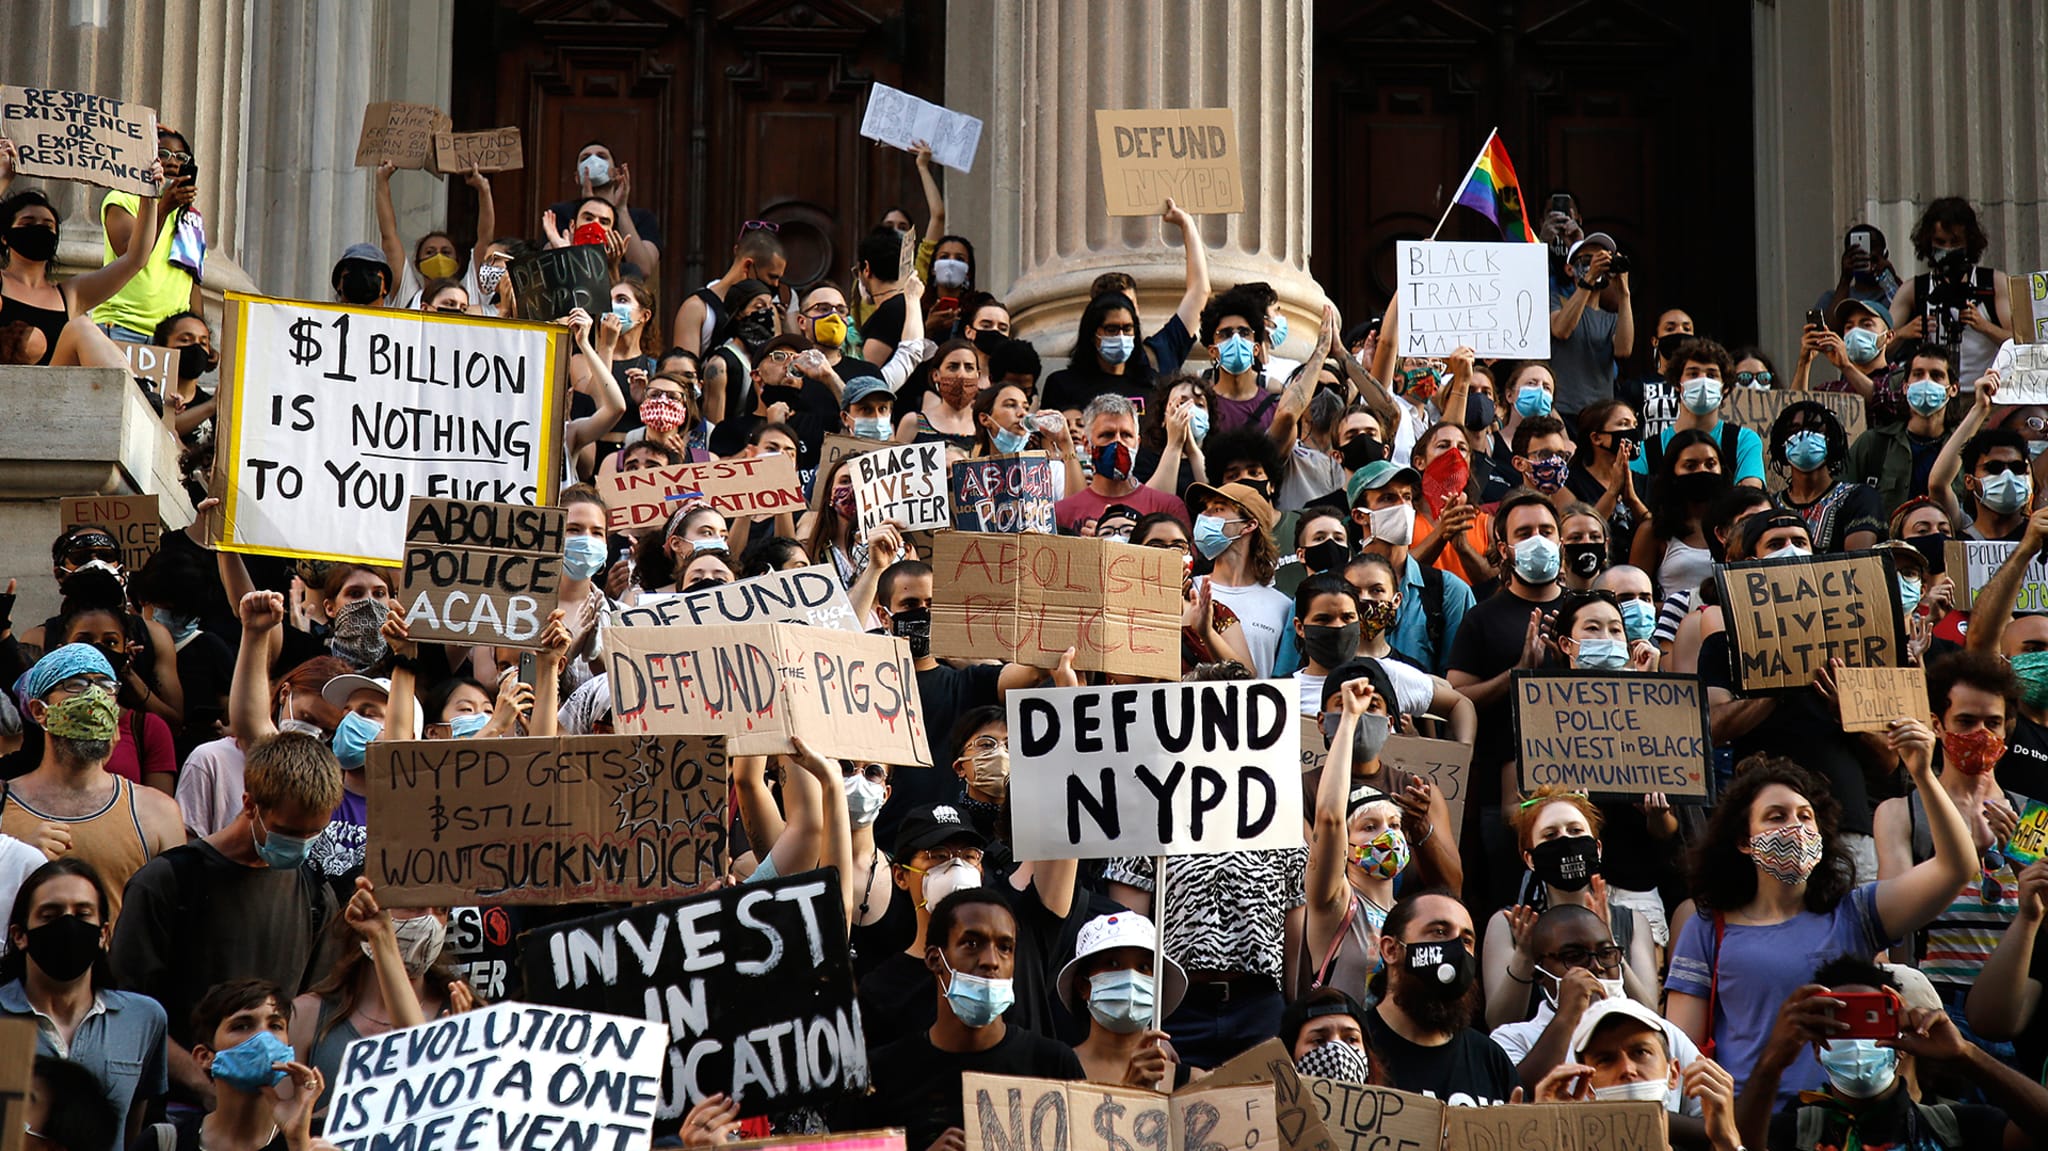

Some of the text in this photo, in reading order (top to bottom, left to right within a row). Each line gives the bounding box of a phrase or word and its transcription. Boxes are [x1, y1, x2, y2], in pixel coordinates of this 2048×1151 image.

[5, 104, 143, 139] EXISTENCE
[24, 89, 124, 117] RESPECT
[38, 134, 123, 160] EXPECT
[66, 123, 96, 141] OR
[440, 135, 517, 151] DEFUND
[1114, 126, 1226, 159] DEFUND
[18, 145, 155, 185] RESISTANCE
[458, 150, 510, 168] NYPD
[1123, 167, 1232, 207] NYPD
[513, 248, 605, 291] DEFUND
[1410, 247, 1501, 276] BLACK
[1408, 279, 1500, 306] TRANS
[1410, 308, 1498, 332] LIVES
[288, 314, 525, 393] $1 BILLION
[271, 395, 530, 471] IS NOTHING
[247, 459, 303, 500] TO
[324, 460, 404, 511] YOU
[614, 459, 763, 491] INVEST
[859, 446, 938, 484] BLACK
[608, 486, 806, 527] EDUATION
[664, 482, 702, 500] IN
[861, 472, 934, 513] LIVES
[75, 501, 130, 522] END
[406, 501, 564, 553] ABOLISH
[863, 495, 947, 540] MATTER
[404, 549, 562, 594] POLICE
[955, 540, 1163, 596] ABOLISH
[1745, 568, 1864, 606] BLACK
[403, 590, 541, 641] ACAB
[964, 594, 1164, 654] POLICE
[1754, 603, 1866, 639] LIVES
[1743, 636, 1888, 680] MATTER
[612, 643, 916, 718] DEFUND THE PIGS!
[1526, 682, 1697, 707] DIVEST FROM
[1840, 669, 1922, 690] ABOLISH THE
[1019, 683, 1287, 757] DEFUND
[1556, 709, 1641, 733] POLICE
[1854, 691, 1906, 719] POLICE
[1526, 735, 1704, 760] INVEST in BLACK
[2013, 744, 2029, 755] Do
[391, 749, 510, 790] NYPD
[527, 749, 626, 787] GETS
[1532, 764, 1687, 786] COMMUNITIES
[453, 803, 574, 830] STILL
[1066, 761, 1277, 845] NYPD
[475, 841, 583, 896] SUCK
[583, 845, 626, 885] MY
[550, 881, 827, 990] INVEST
[644, 978, 709, 1043] IN
[344, 1008, 645, 1086] REVOLUTION
[329, 1056, 660, 1134] IS NOT A ONE
[1312, 1078, 1404, 1133] STOP
[454, 1107, 648, 1151] EVENT
[976, 1088, 1067, 1151] NO
[1464, 1112, 1650, 1151] DISARM
